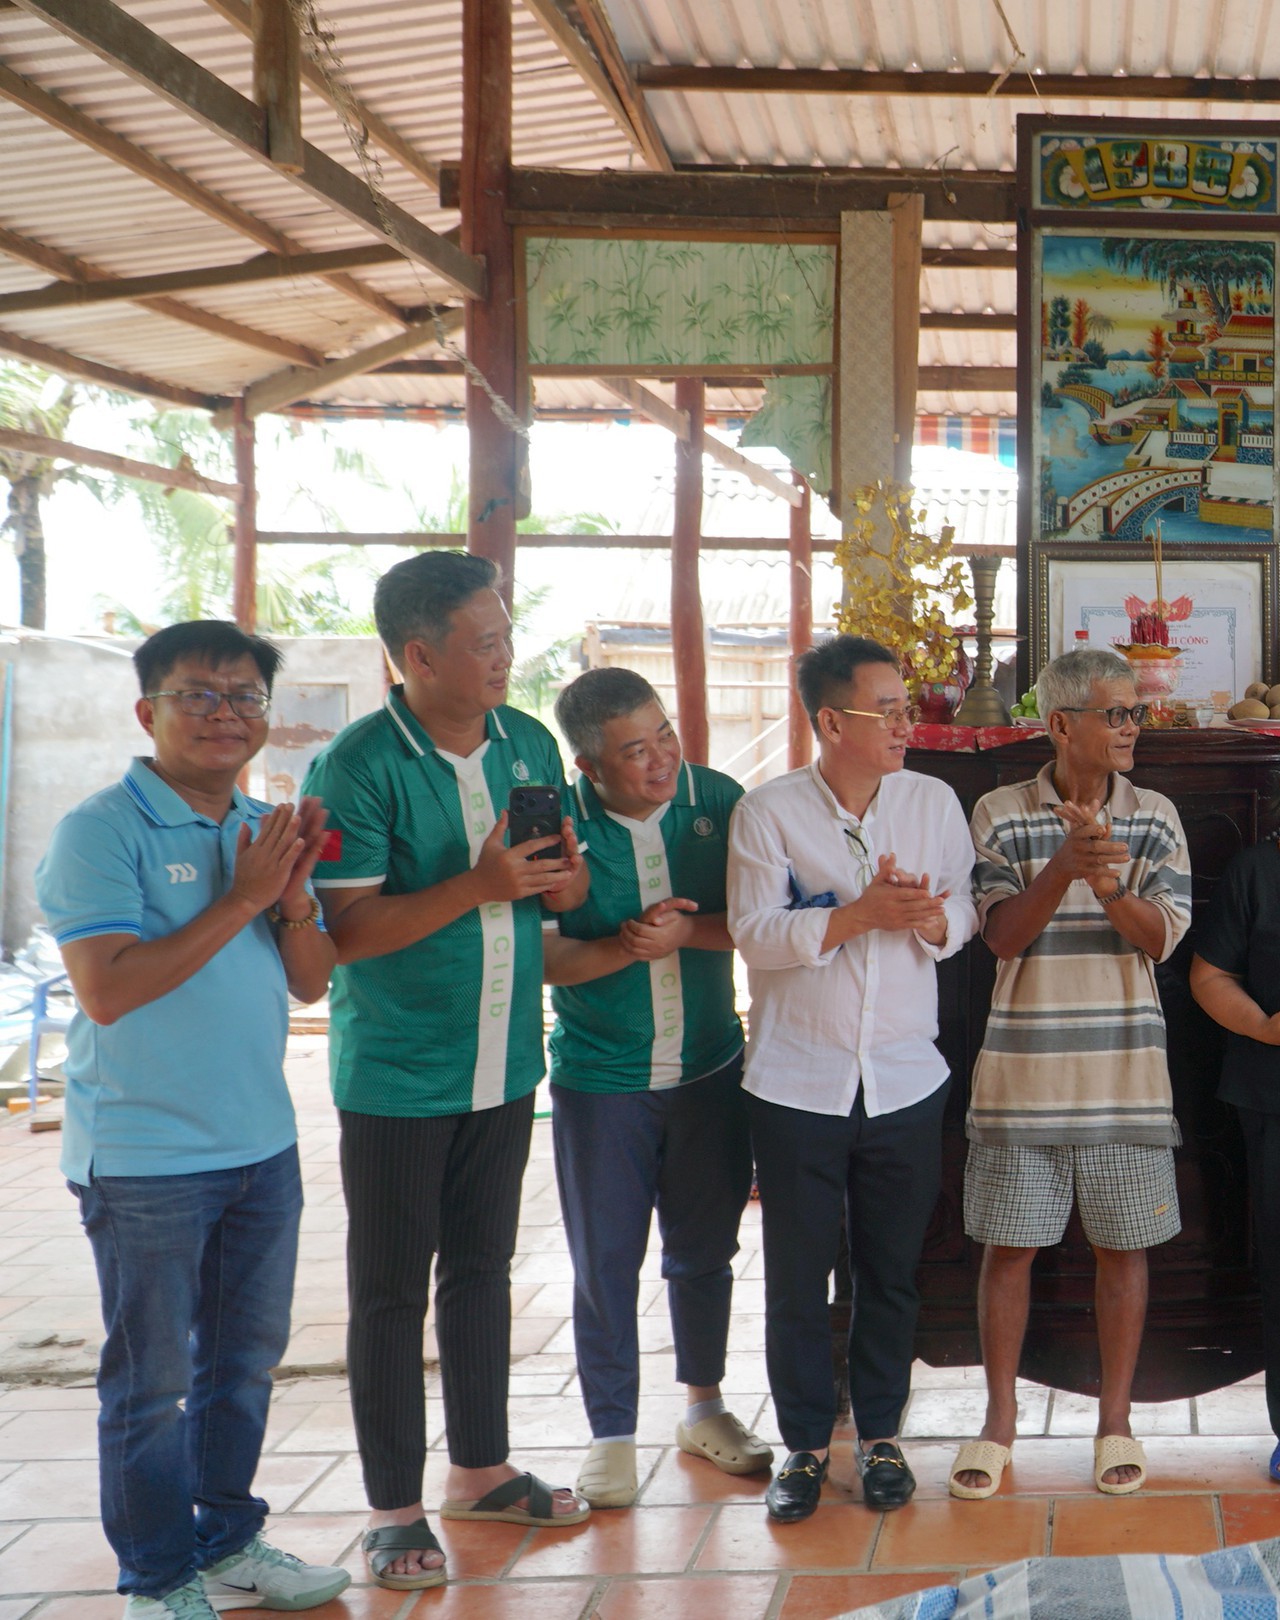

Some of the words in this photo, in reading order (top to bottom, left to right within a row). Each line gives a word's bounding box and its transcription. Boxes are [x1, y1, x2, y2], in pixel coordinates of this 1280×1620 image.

[1084, 142, 1234, 197] 1988
[490, 935, 509, 1018] Club
[660, 972, 679, 1038] Club
